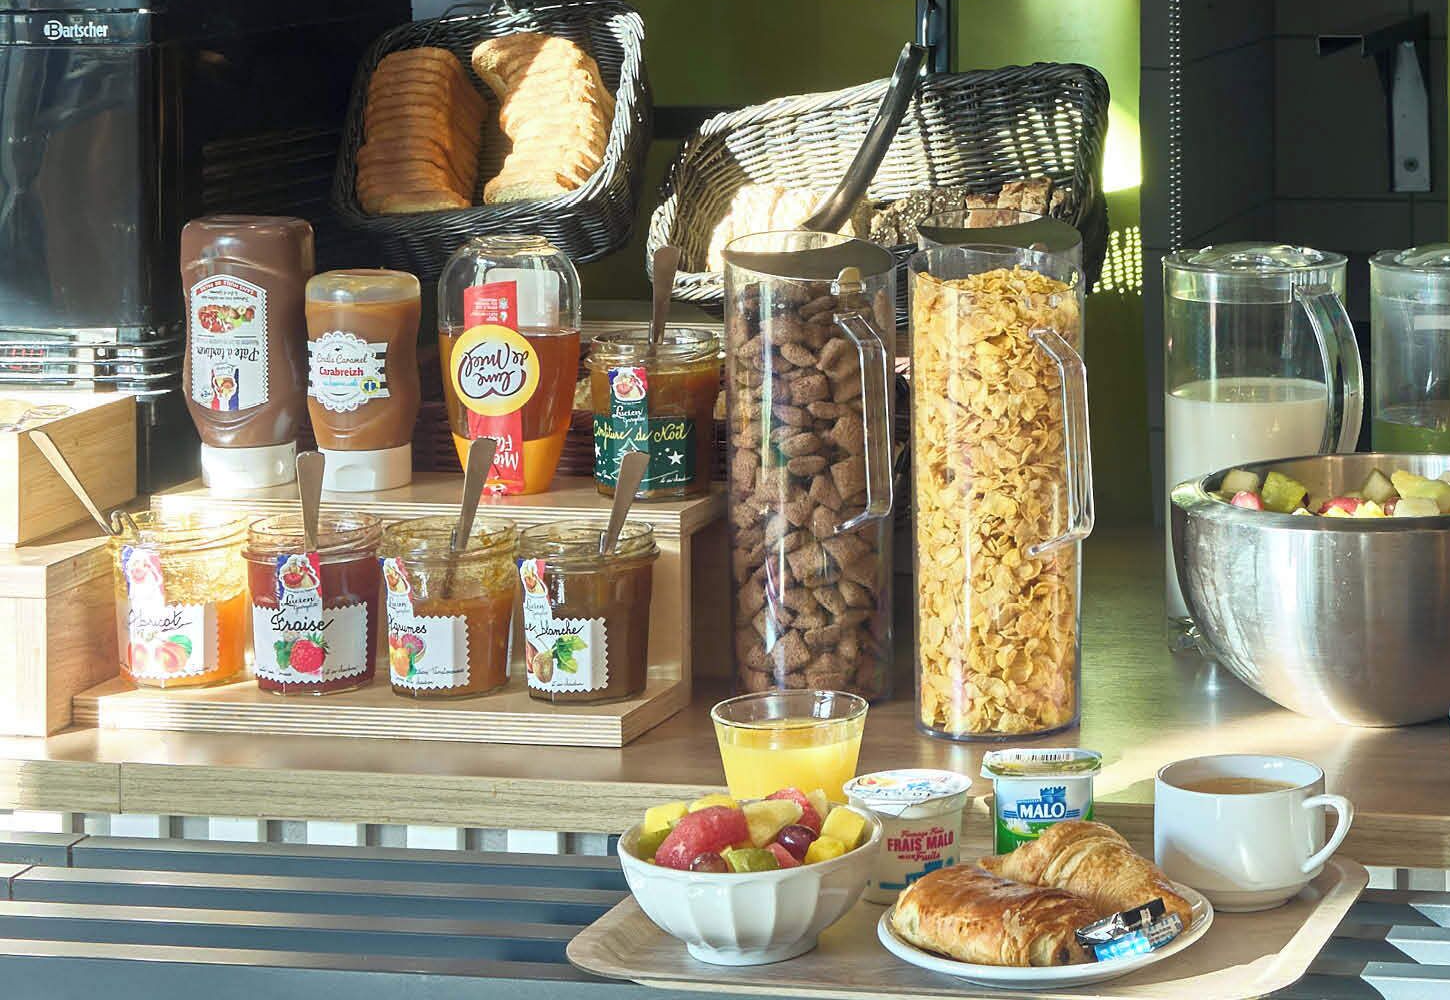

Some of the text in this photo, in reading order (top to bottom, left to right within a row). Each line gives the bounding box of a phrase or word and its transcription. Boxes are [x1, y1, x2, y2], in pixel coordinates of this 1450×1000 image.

[43, 19, 109, 41] Bartscher
[320, 366, 364, 377] Carabreizh
[493, 451, 519, 472] Mie
[270, 608, 334, 631] Fraise
[536, 619, 584, 638] blanche
[1020, 802, 1066, 819] MALO
[887, 830, 954, 852] FRAIS MALO
